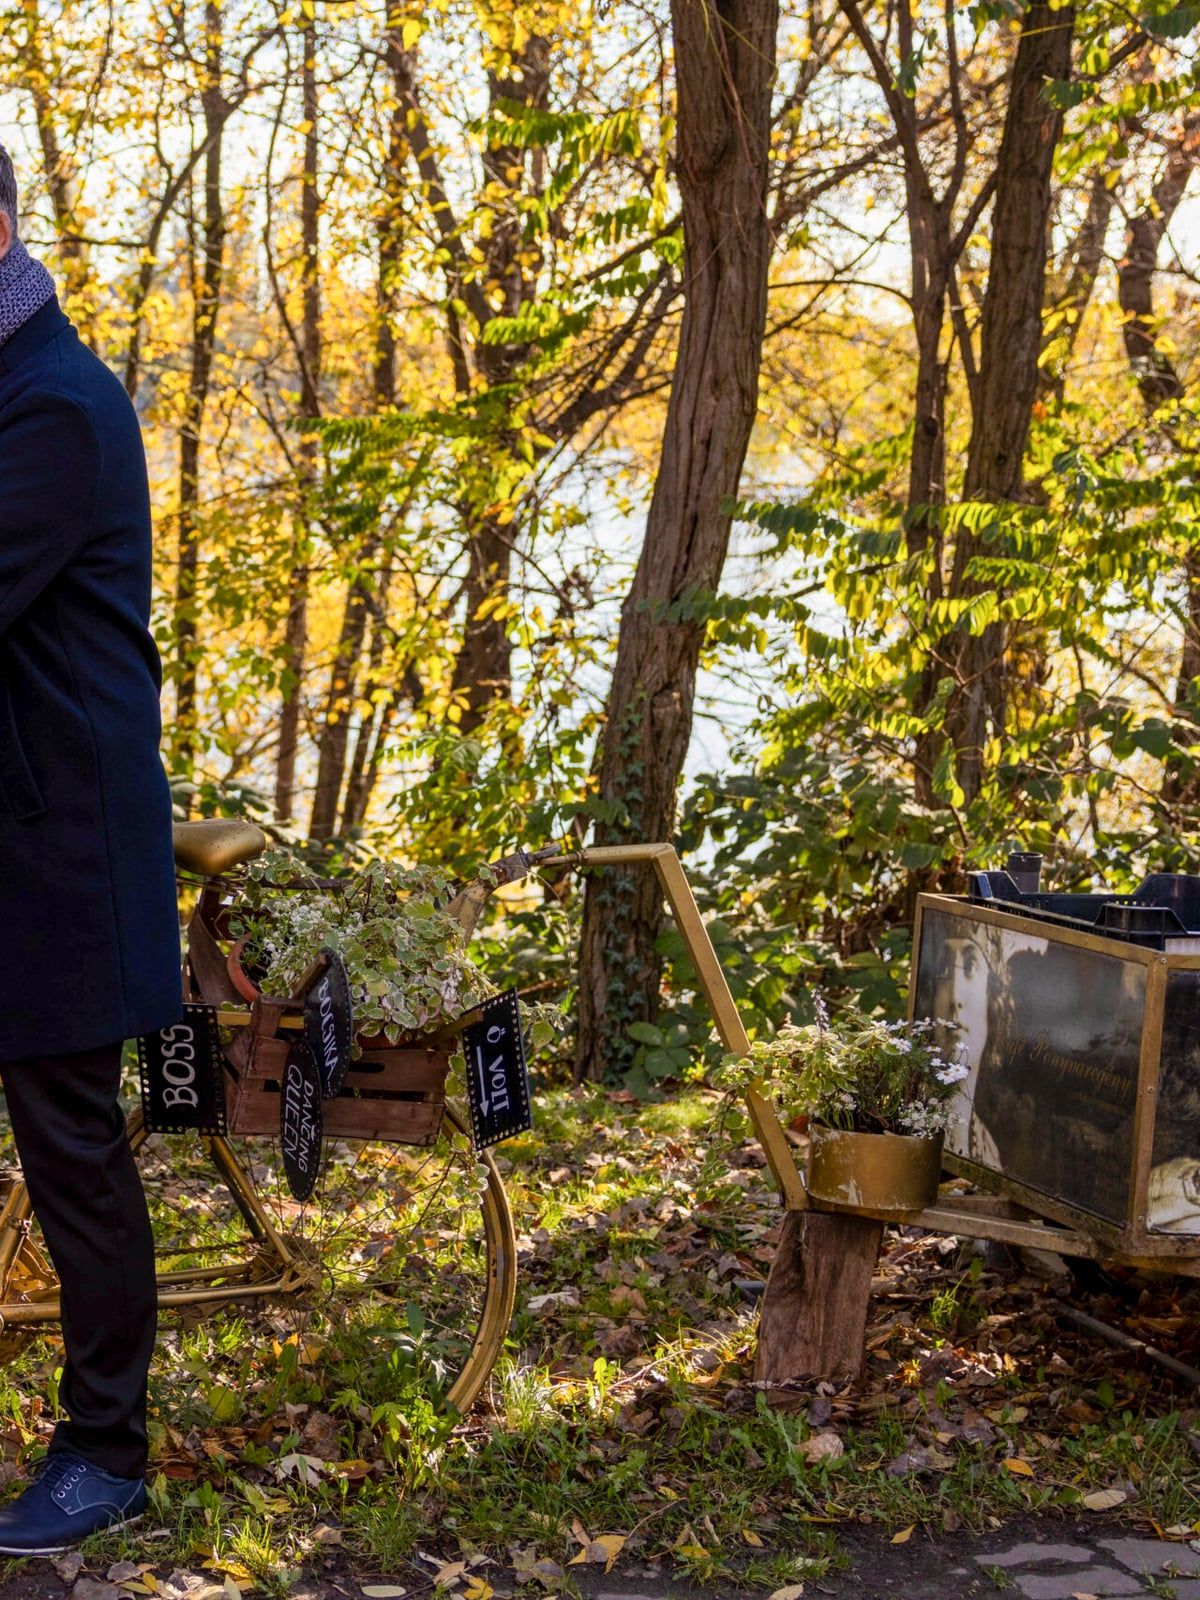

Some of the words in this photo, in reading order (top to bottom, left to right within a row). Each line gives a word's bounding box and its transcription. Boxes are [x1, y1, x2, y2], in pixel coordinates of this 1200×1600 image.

[159, 1024, 199, 1109] BOSS
[283, 1064, 303, 1161] QUEEN
[298, 1079, 314, 1173] DANCING
